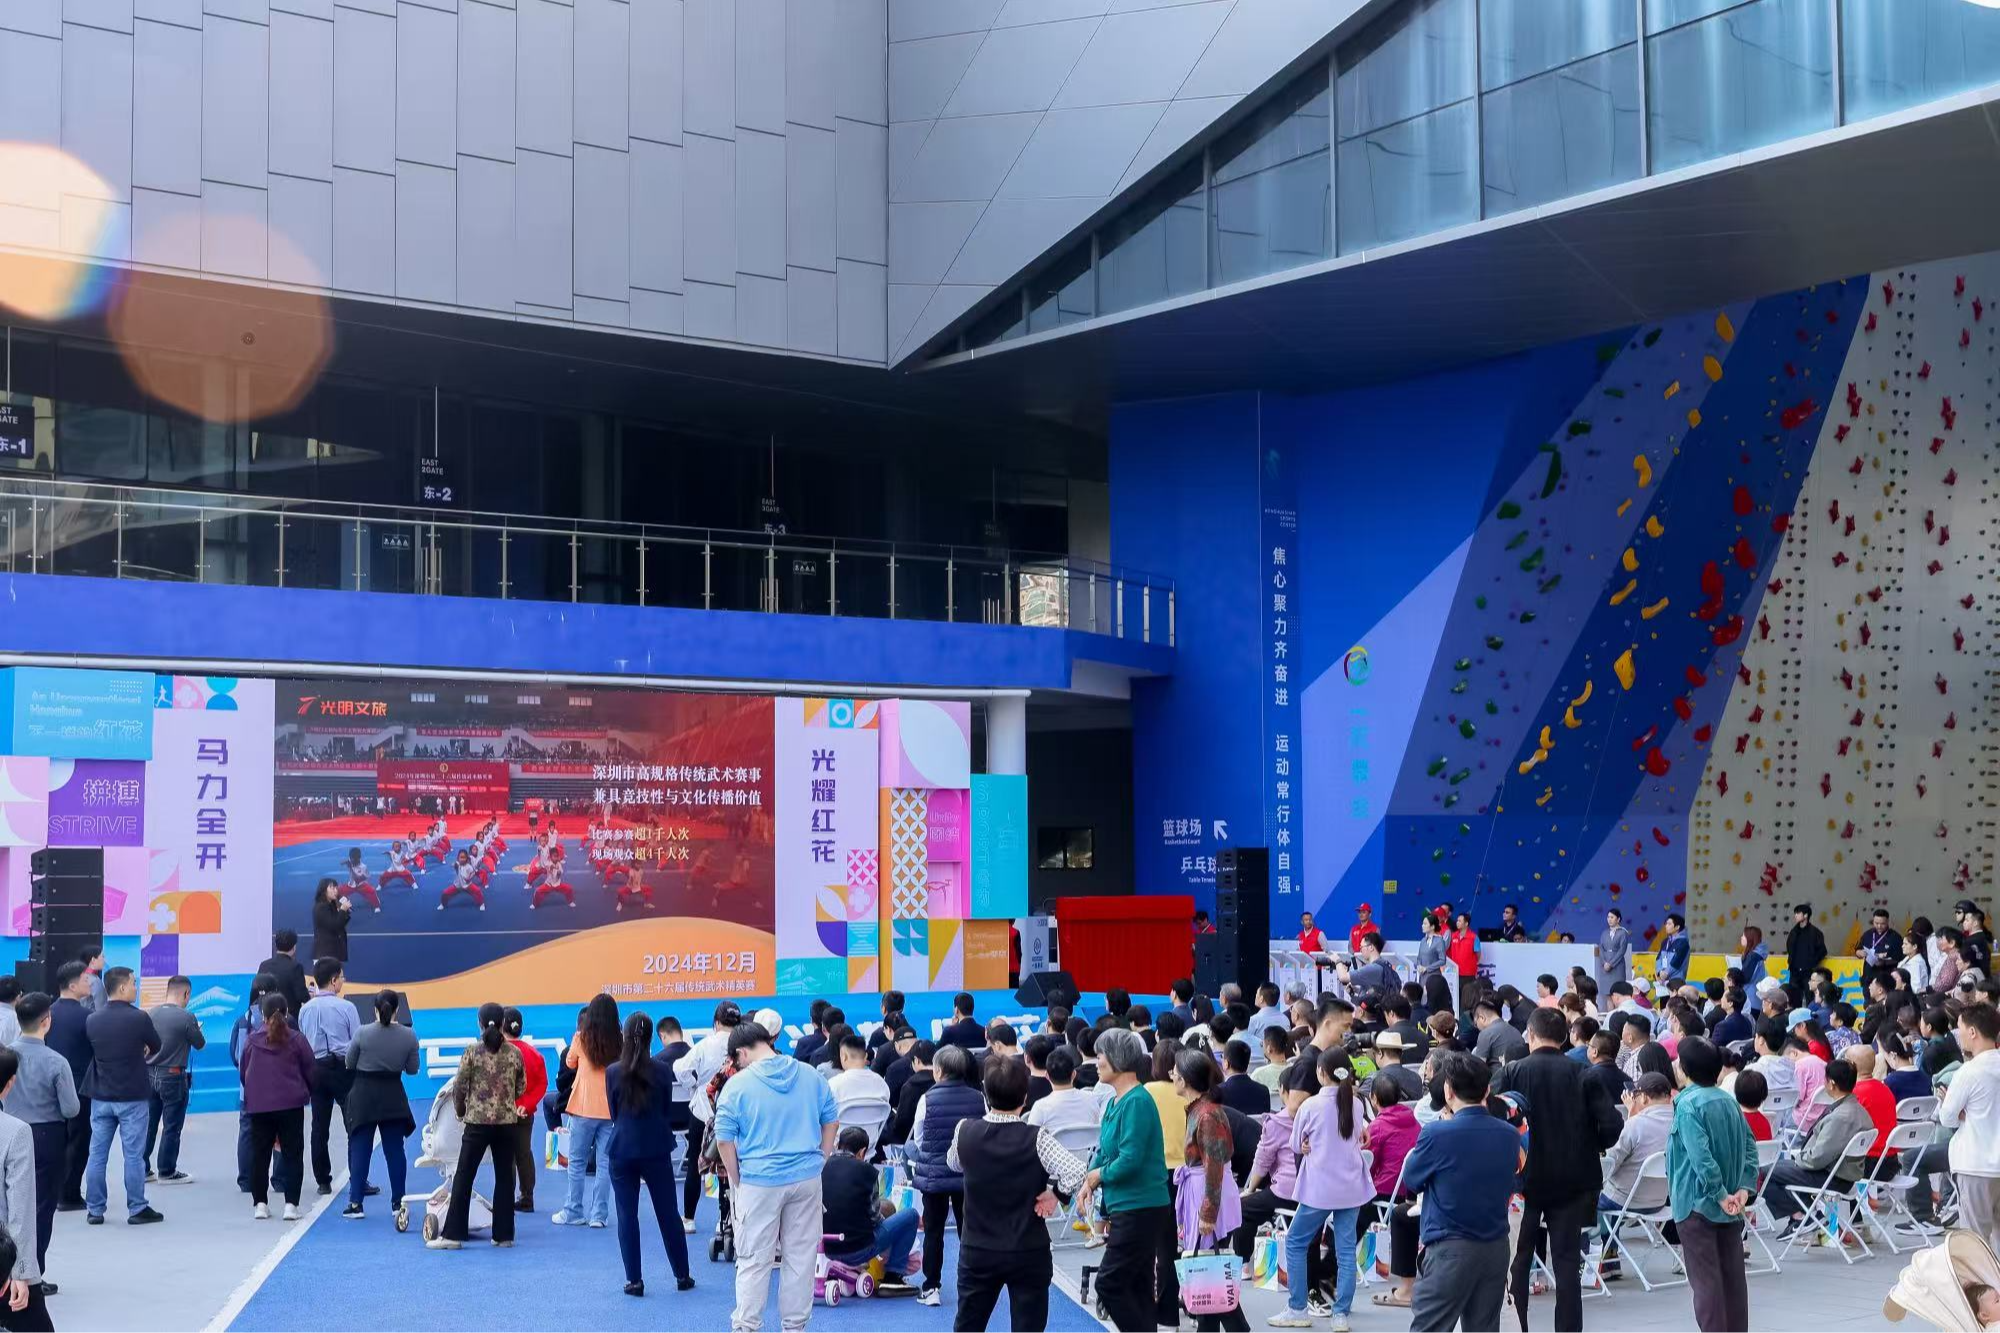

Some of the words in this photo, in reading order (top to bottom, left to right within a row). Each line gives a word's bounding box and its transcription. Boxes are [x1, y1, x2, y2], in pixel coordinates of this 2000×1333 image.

[421, 458, 439, 466] EAST
[424, 485, 452, 501] 东-2
[1273, 547, 1288, 706] 焦心聚力齐奋进
[320, 700, 388, 717] 光明文旅
[592, 764, 762, 783] 深圳市高规格传统武术赛事
[83, 778, 140, 806] 拼搏
[592, 787, 762, 807] 兼具竞技性与文化传播价值
[195, 738, 229, 870] 马力全开
[811, 748, 836, 863] 光耀红花
[48, 815, 138, 838] STRIVE
[1163, 819, 1202, 837] 篮球场
[643, 951, 756, 975] 2024年12月
[601, 979, 756, 996] 深圳市第二十六届传统武术精英赛
